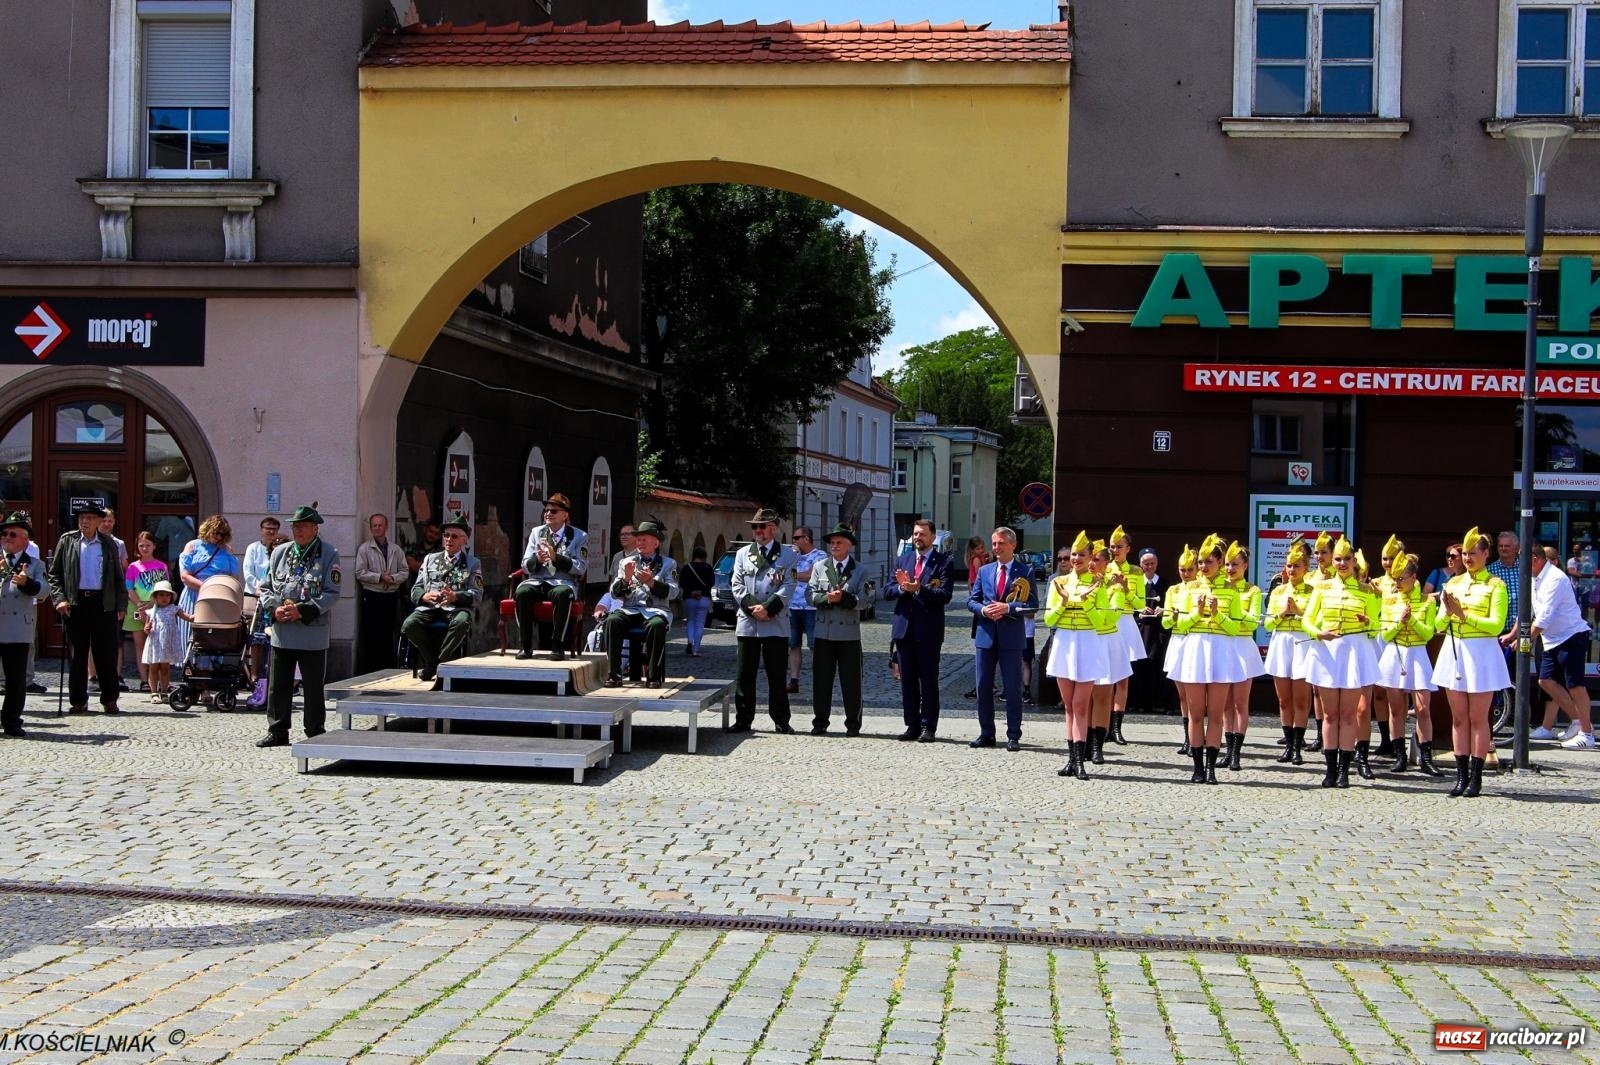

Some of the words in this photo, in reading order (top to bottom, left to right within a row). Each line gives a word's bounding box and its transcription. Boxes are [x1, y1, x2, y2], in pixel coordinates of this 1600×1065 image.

[1548, 342, 1600, 360] PO
[1195, 369, 1281, 388] RYNEK
[1288, 370, 1317, 389] 12
[1338, 371, 1463, 391] CENTRUM
[1156, 437, 1167, 447] 12
[1283, 515, 1342, 524] APTEKA
